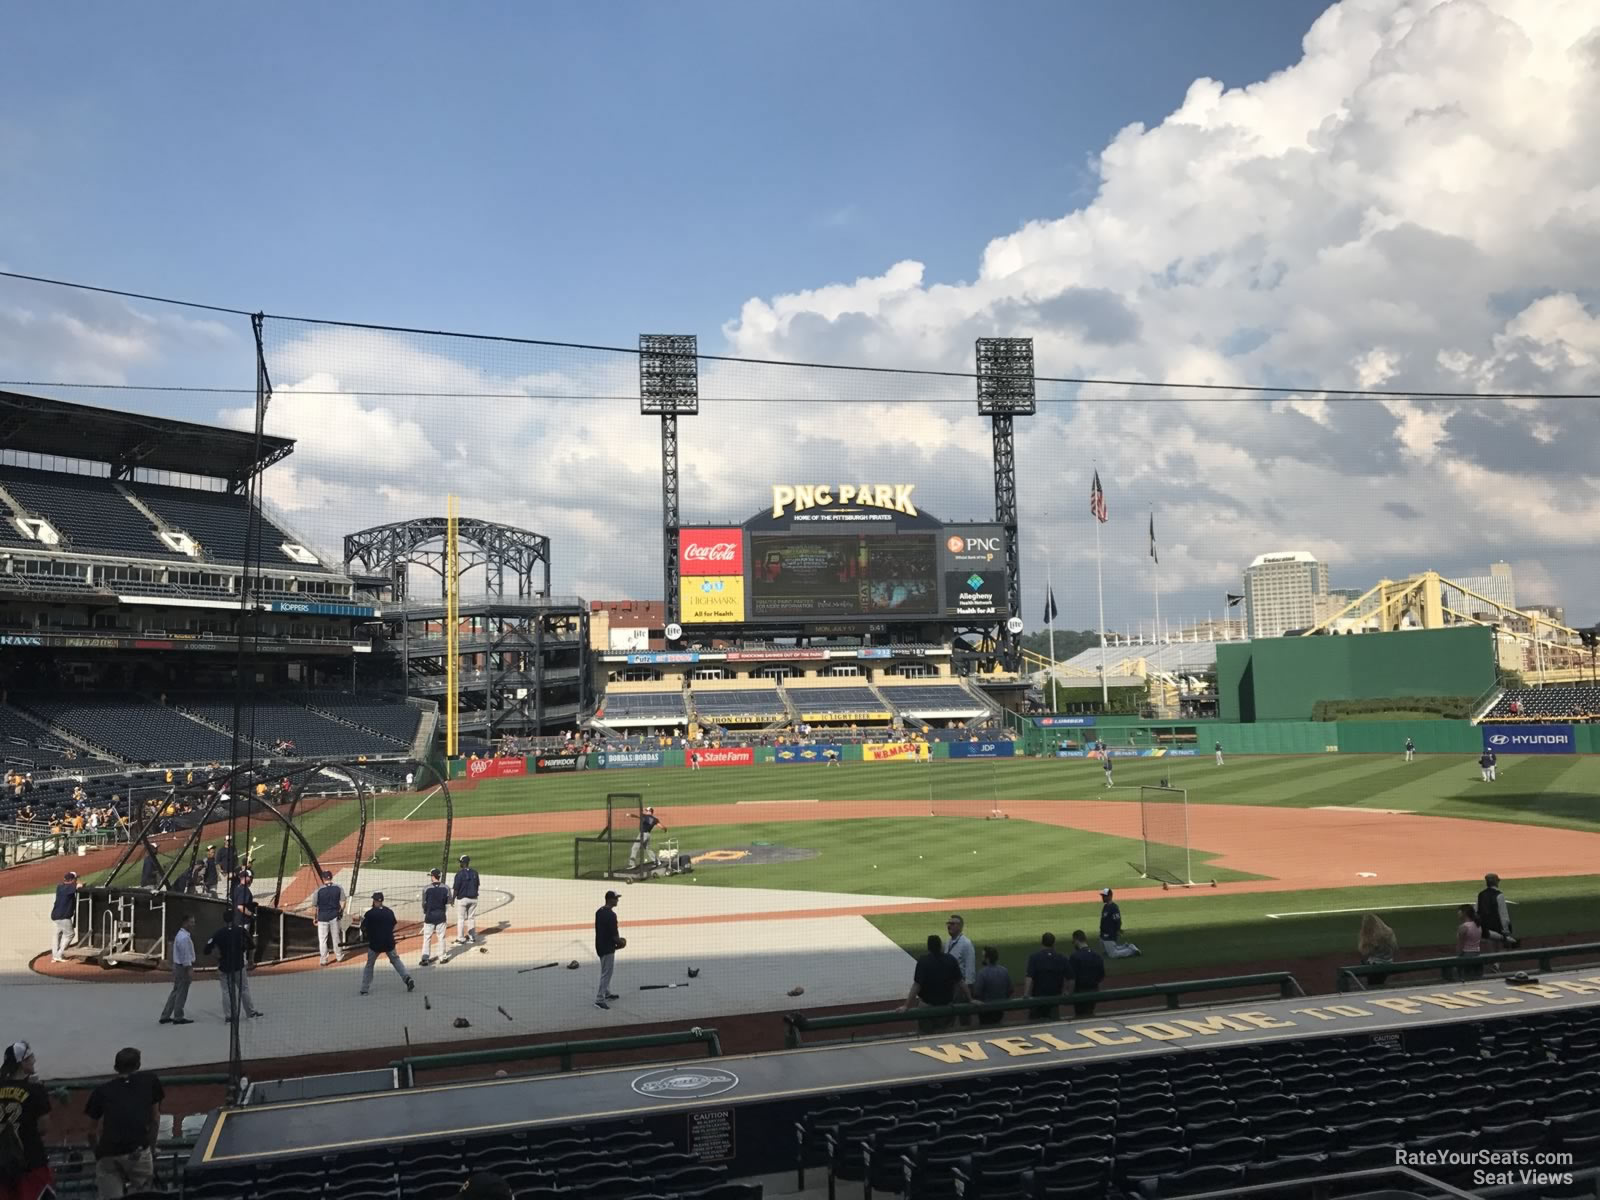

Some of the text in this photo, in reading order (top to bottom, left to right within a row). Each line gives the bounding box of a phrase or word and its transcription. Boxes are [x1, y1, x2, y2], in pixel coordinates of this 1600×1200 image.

[772, 484, 918, 519] PNC PARK
[966, 537, 1000, 551] PNC
[684, 543, 737, 561] Coca-Cola
[959, 593, 992, 601] Allegheny
[280, 602, 309, 612] KOPPERS
[667, 627, 681, 637] Lite
[1512, 735, 1568, 744] HYUNDAI
[981, 744, 995, 752] JDP
[608, 753, 659, 762] BORDAS BORDAS
[909, 1010, 1298, 1064] WELCOME
[1290, 1004, 1374, 1020] TO
[1366, 989, 1524, 1015] PNC
[693, 1111, 729, 1121] CAUTION
